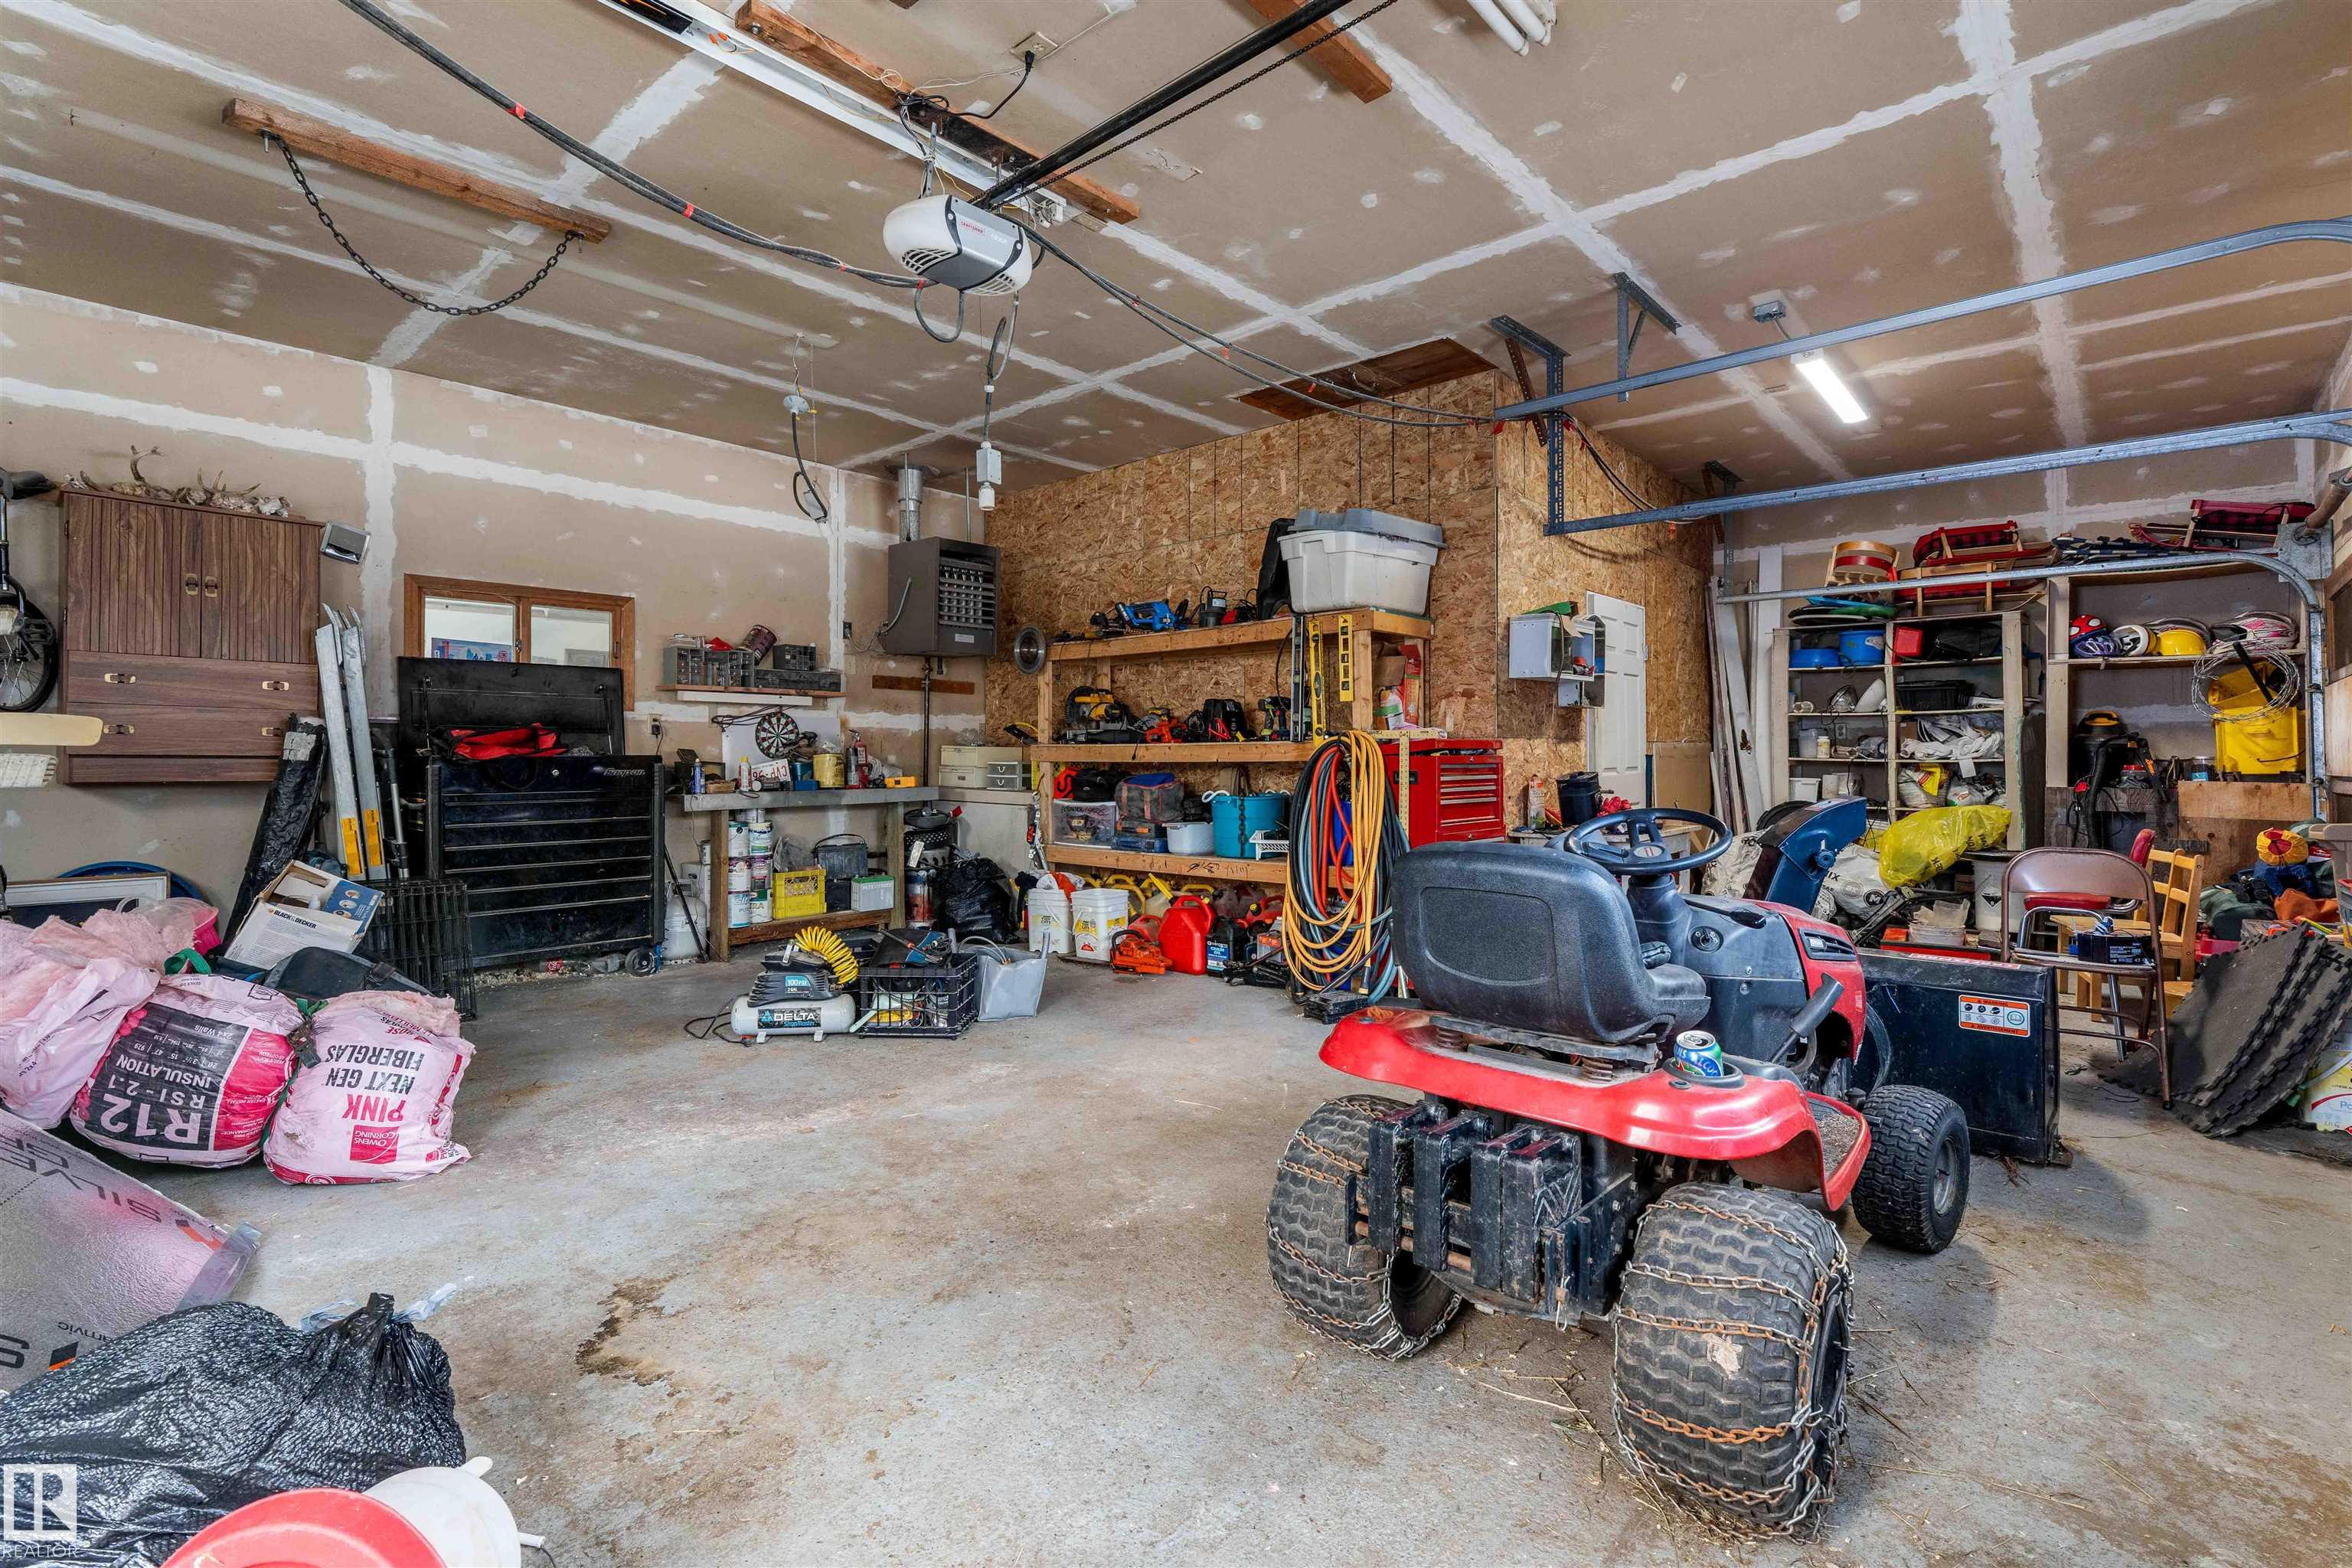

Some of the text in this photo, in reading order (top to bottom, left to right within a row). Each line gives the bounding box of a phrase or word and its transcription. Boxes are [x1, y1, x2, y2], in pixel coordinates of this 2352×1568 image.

[774, 1011, 815, 1021] DELTA
[194, 1024, 216, 1037] Walls
[116, 1054, 213, 1089] INSULATION
[325, 1067, 416, 1096] NEXT GEN
[162, 1089, 206, 1109] RSI
[341, 1093, 407, 1123] PINK
[100, 1093, 202, 1145] R12
[354, 1129, 398, 1140] CORNING
[354, 1137, 387, 1147] OWENS
